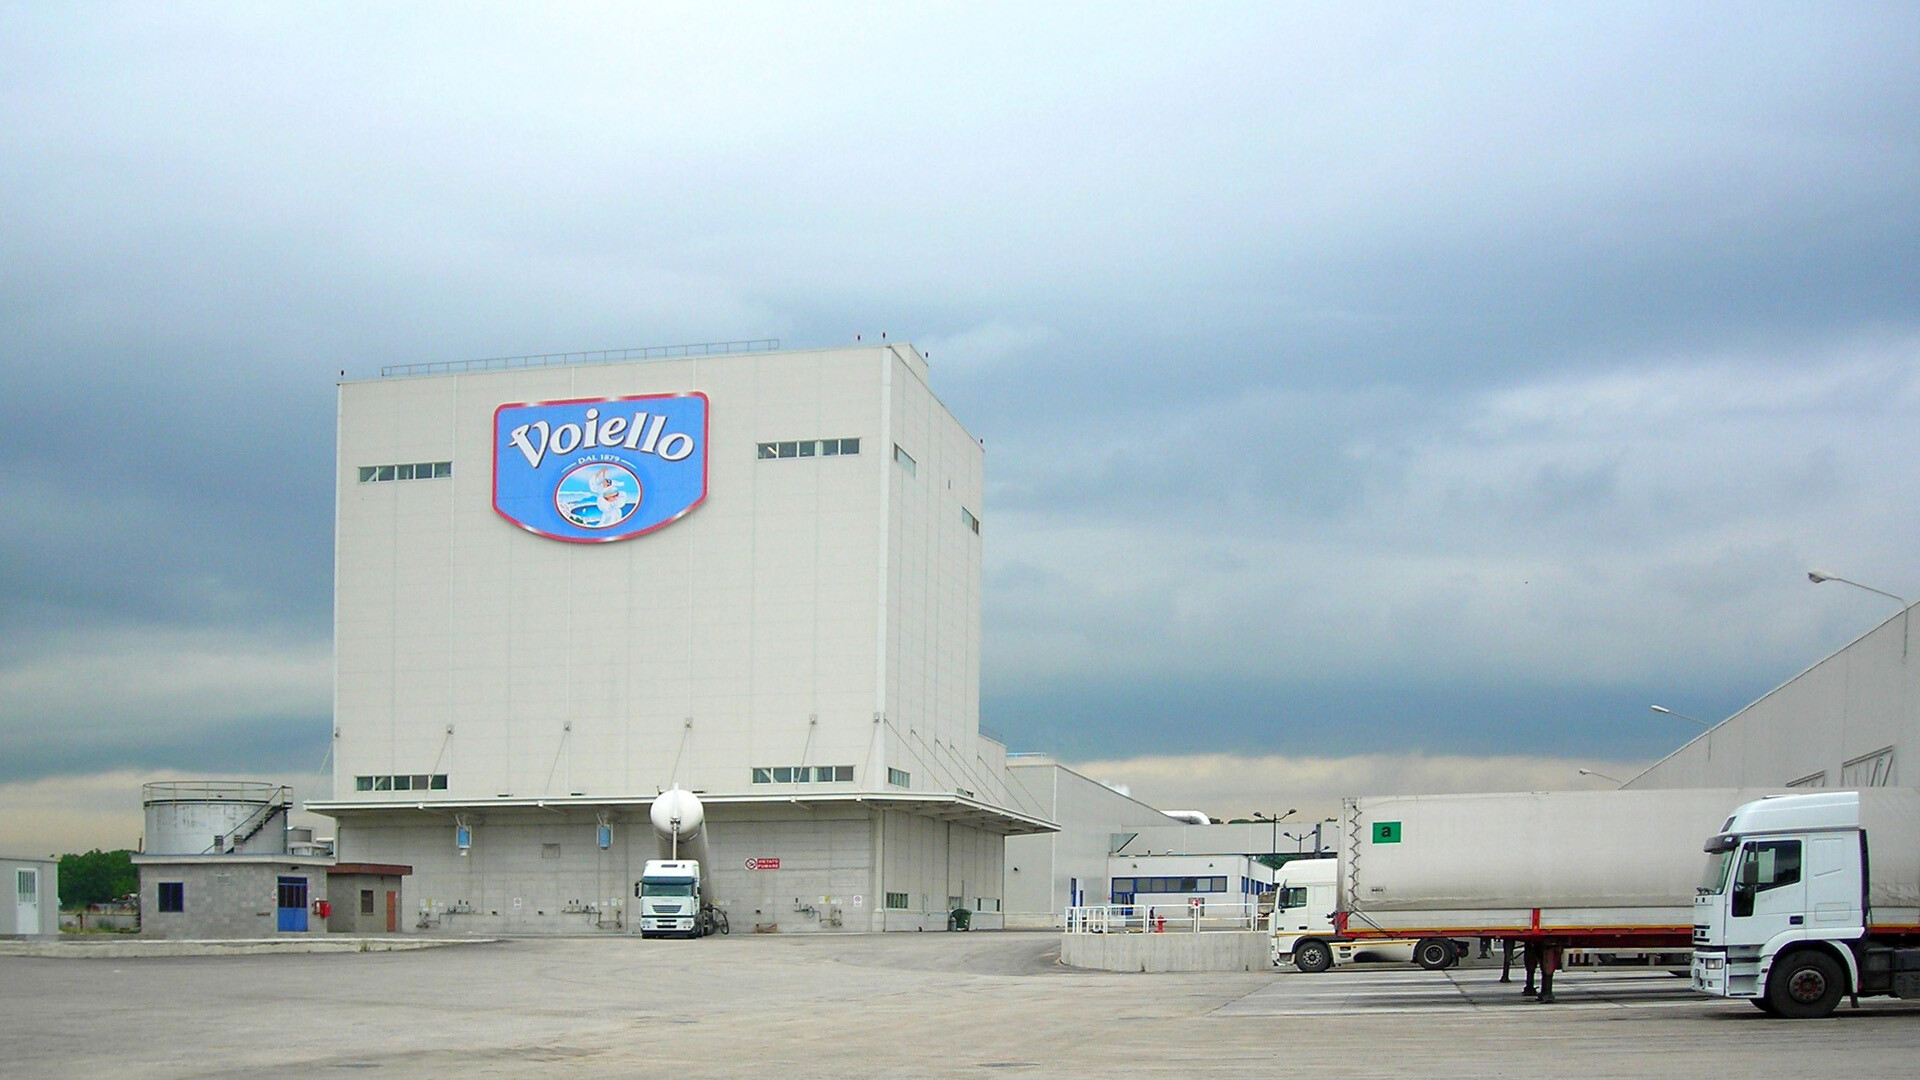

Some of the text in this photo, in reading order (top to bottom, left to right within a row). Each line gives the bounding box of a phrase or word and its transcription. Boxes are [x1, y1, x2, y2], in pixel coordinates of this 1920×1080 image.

[508, 408, 694, 468] Voiello
[578, 454, 620, 465] DAL 1879
[1381, 826, 1391, 838] a
